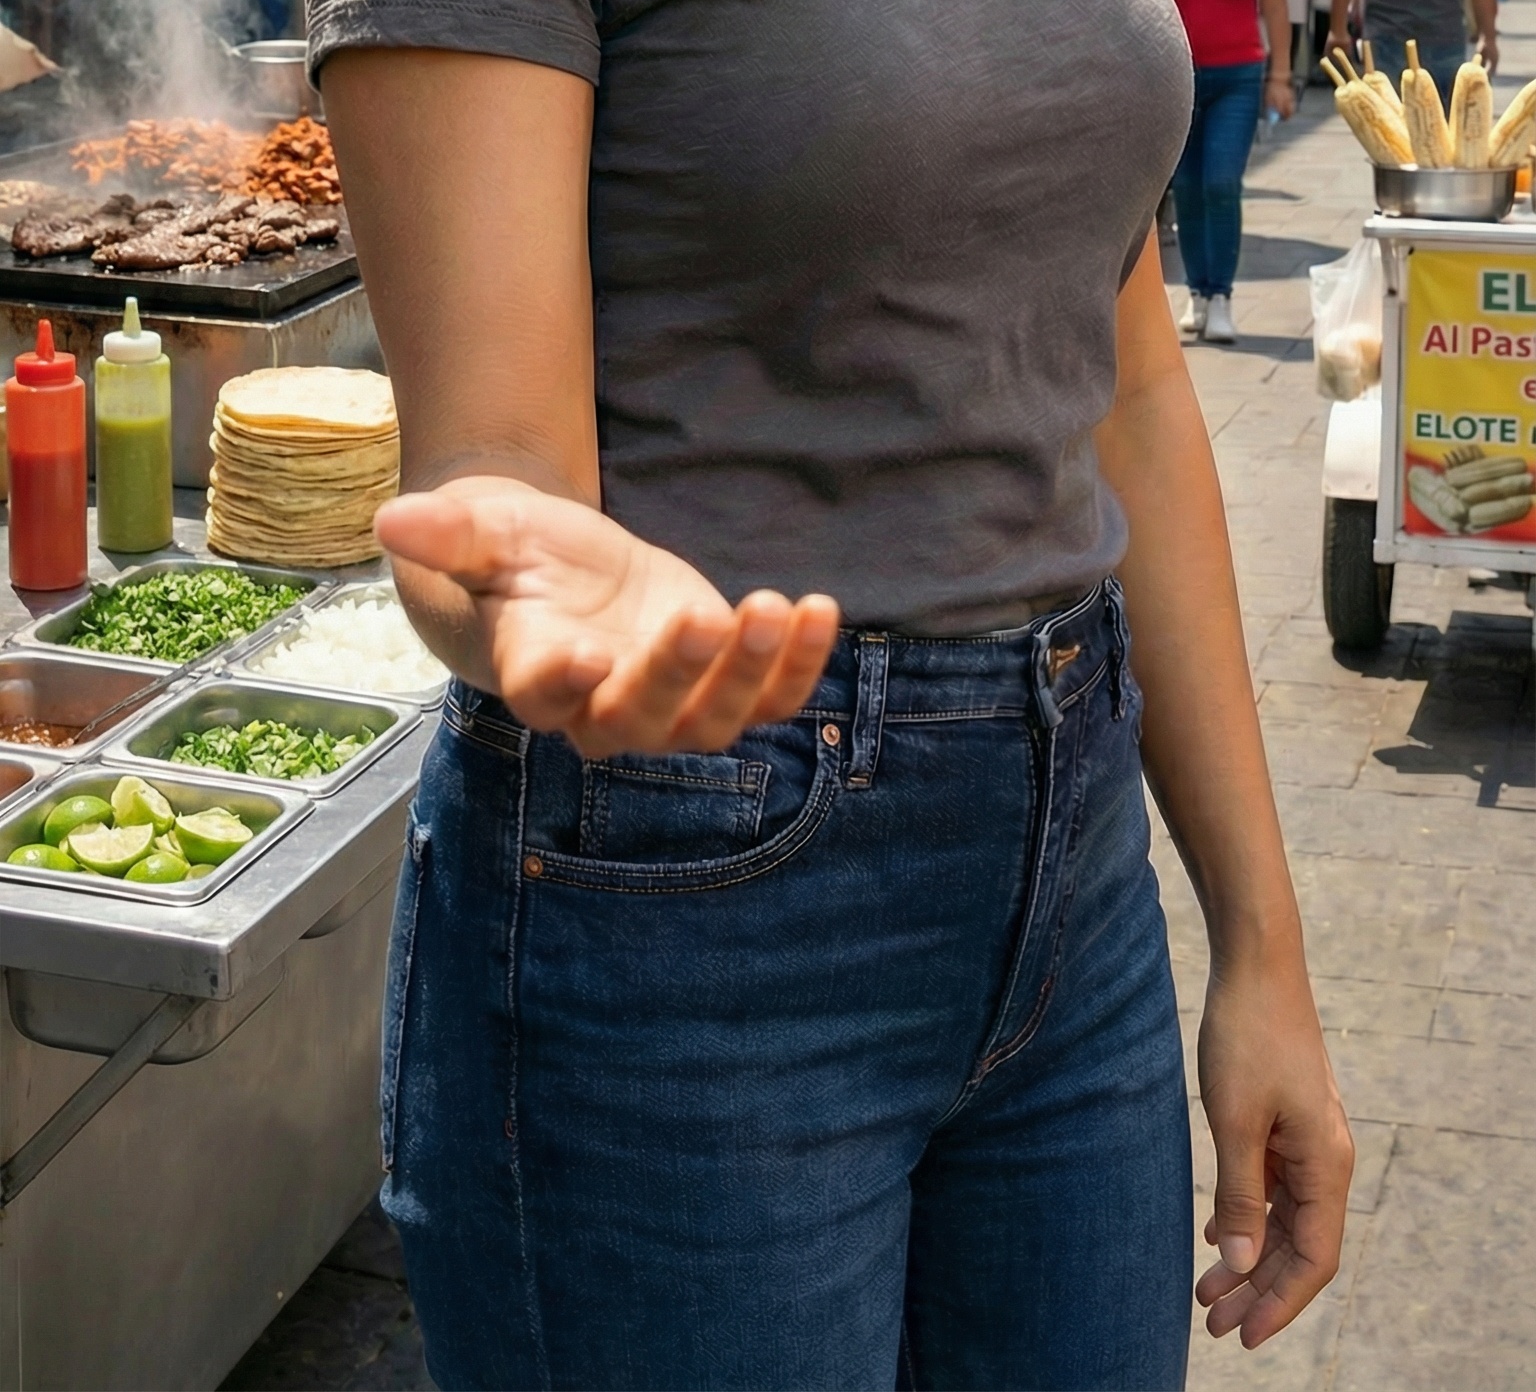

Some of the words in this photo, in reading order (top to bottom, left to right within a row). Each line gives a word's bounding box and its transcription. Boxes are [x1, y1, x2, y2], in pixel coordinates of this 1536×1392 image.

[1483, 272, 1536, 312] EL
[1424, 324, 1458, 354] Al
[1472, 327, 1536, 358] Pas
[1416, 413, 1517, 443] ELOTE
